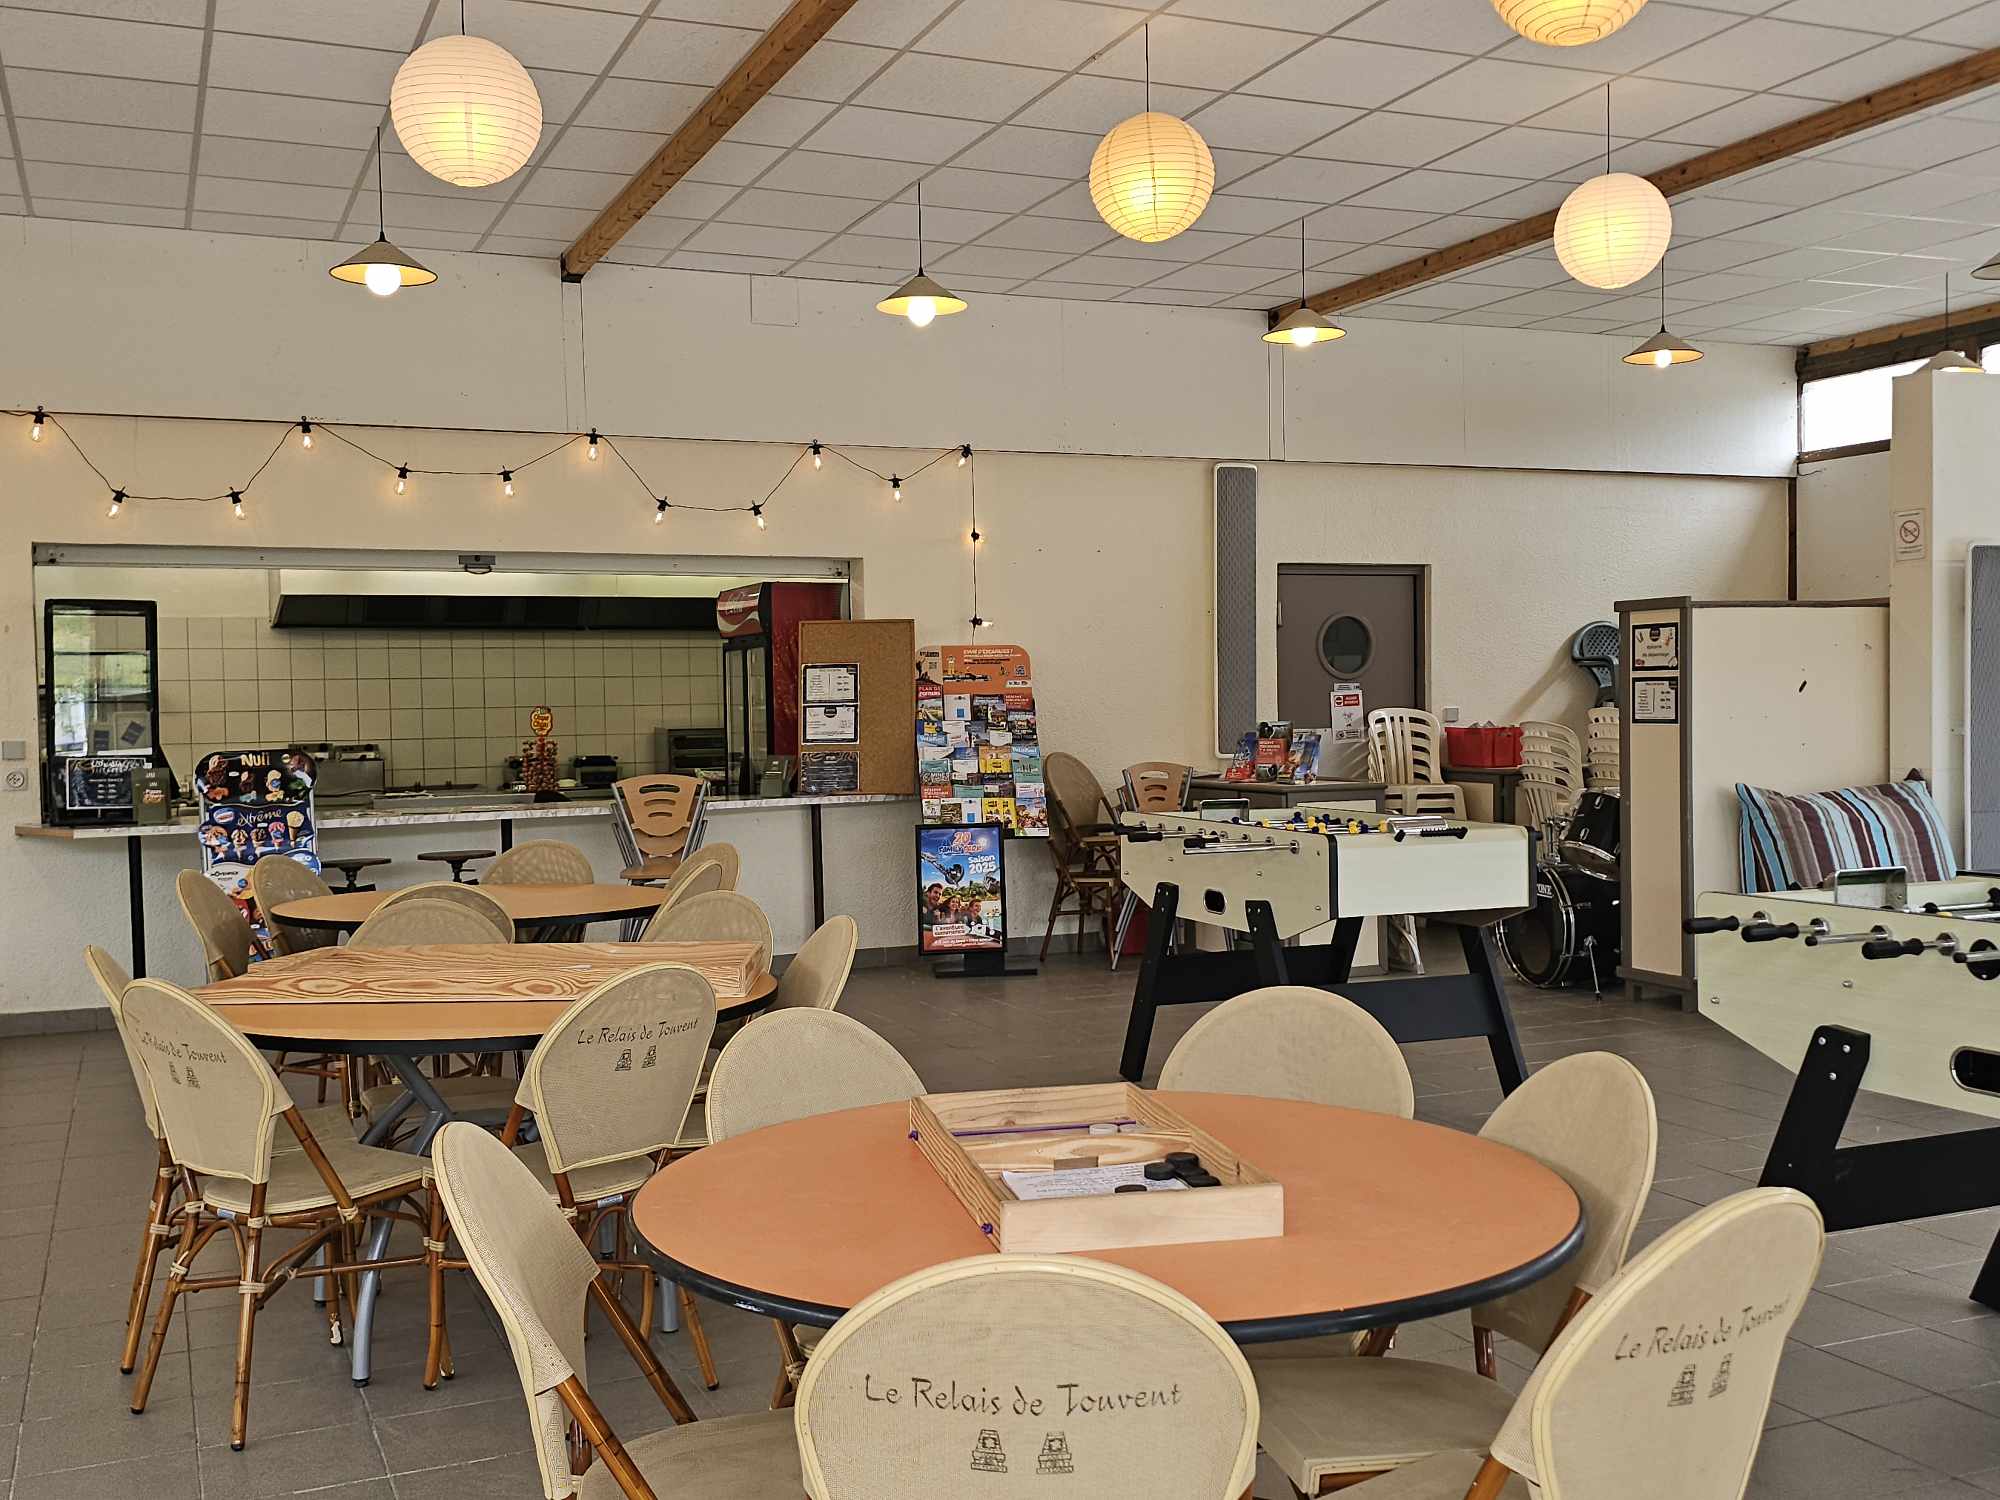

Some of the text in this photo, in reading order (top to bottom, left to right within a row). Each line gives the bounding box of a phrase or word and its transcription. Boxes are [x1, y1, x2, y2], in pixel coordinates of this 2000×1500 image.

[968, 855, 995, 863] Saison
[968, 861, 996, 874] 2025
[577, 1018, 699, 1045] Le Relais de Touvent
[1615, 1333, 1641, 1361] Le
[1647, 1323, 1709, 1358] Relais
[1713, 1316, 1732, 1345] de
[864, 1374, 1184, 1417] Le Relais de Touvent
